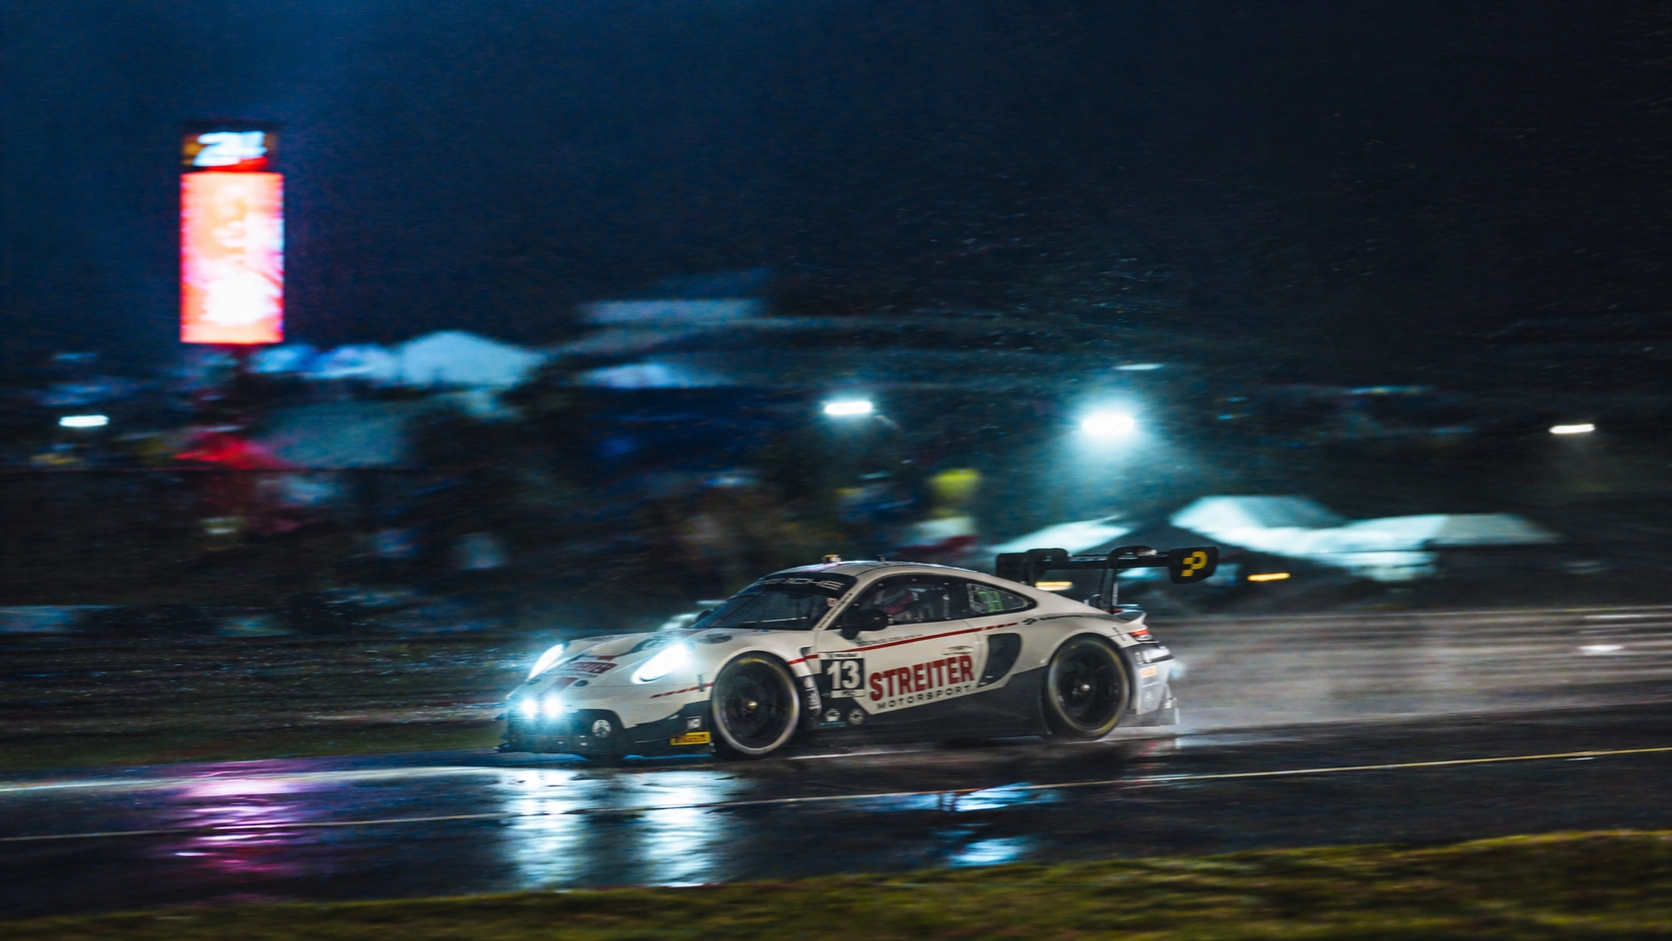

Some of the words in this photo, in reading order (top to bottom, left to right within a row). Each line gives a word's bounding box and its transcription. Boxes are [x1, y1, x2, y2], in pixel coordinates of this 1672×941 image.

[826, 661, 861, 690] 13
[869, 655, 975, 701] STREITER
[876, 685, 970, 710] MOTORSPORT
